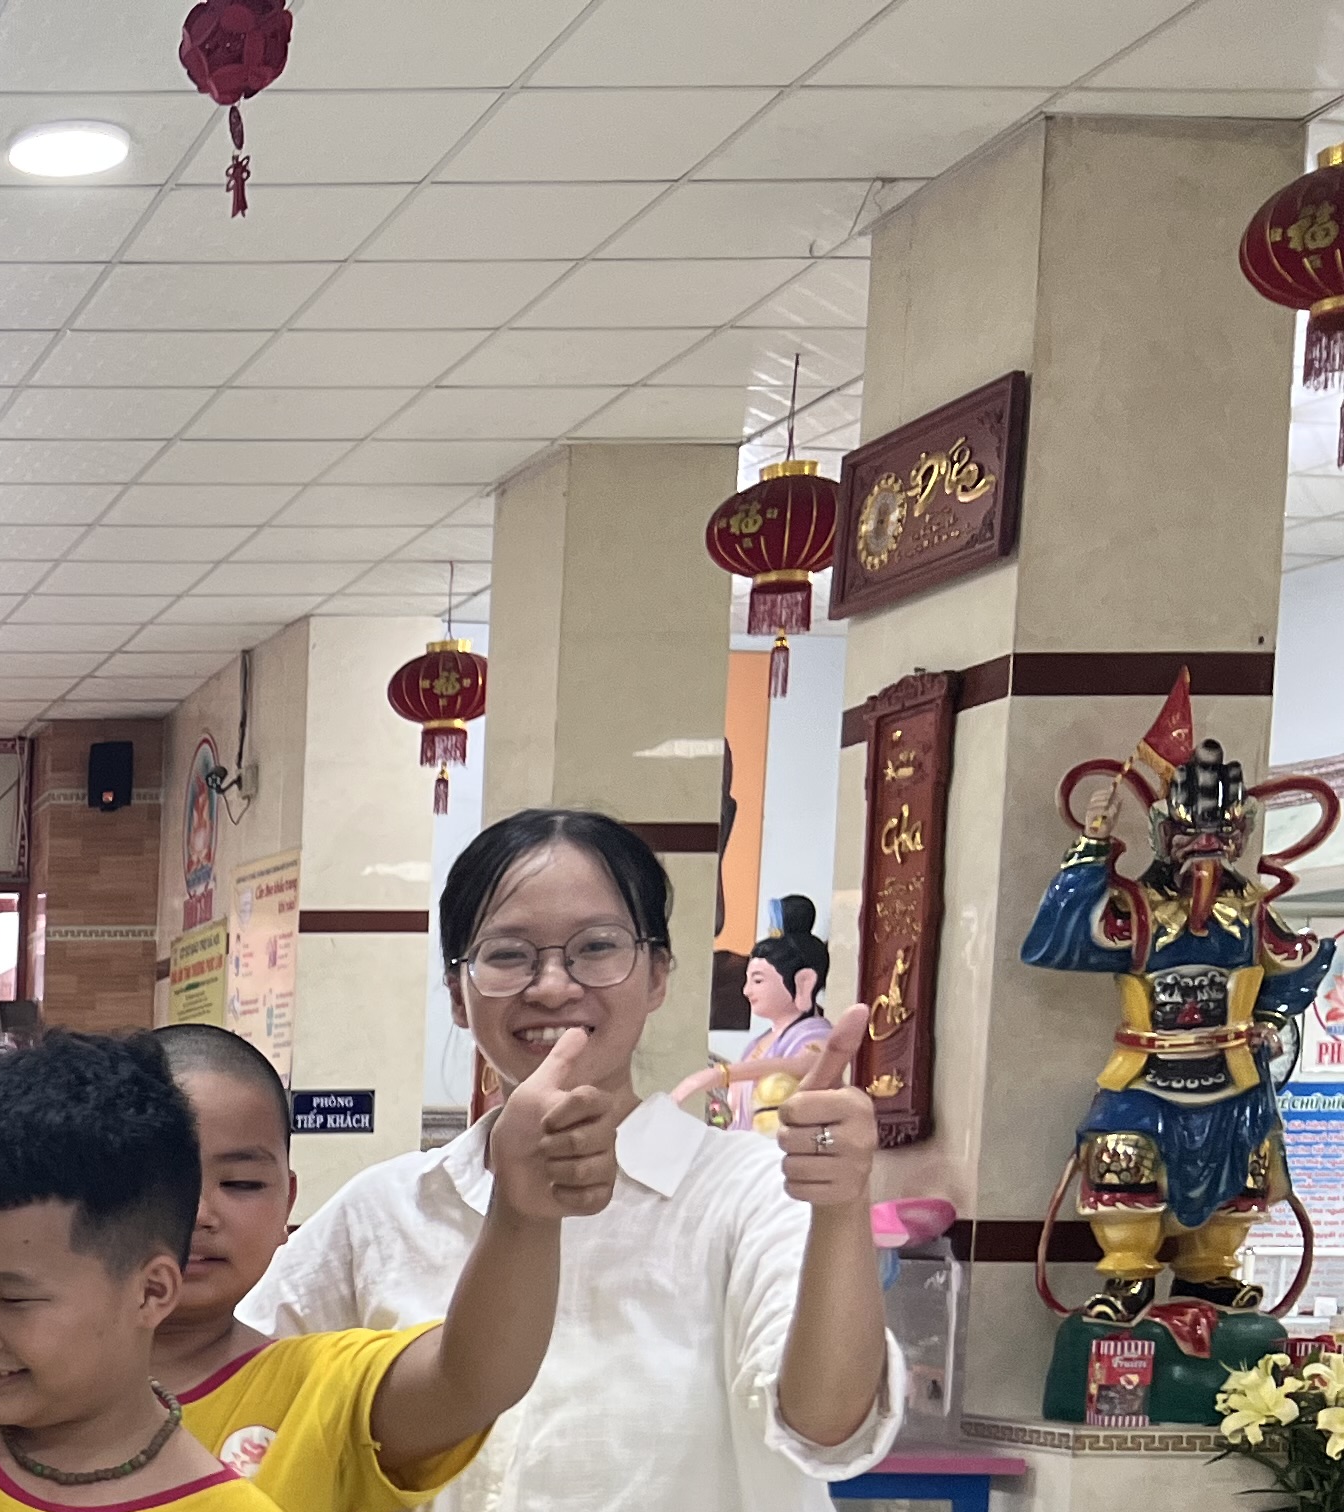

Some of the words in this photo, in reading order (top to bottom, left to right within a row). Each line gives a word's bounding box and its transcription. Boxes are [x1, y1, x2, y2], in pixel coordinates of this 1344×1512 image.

[311, 1093, 354, 1109] PHÒNG
[295, 1108, 324, 1129] TIẾP
[326, 1110, 370, 1129] KHÁCH
